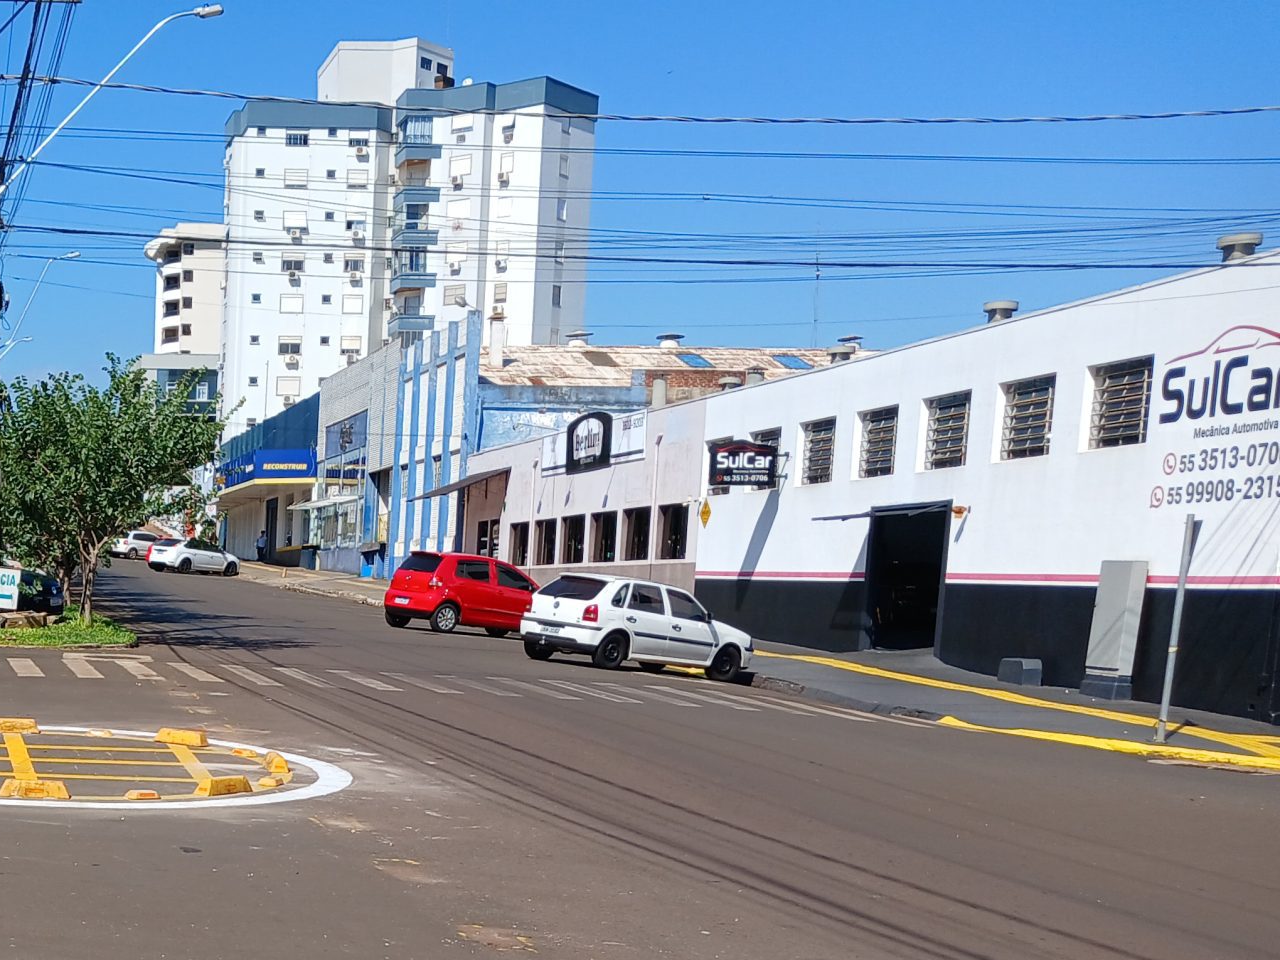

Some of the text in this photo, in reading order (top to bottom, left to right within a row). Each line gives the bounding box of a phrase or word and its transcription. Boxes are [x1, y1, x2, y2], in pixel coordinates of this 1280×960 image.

[1193, 418, 1279, 439] Mecânica Automotiva
[716, 452, 772, 469] SulCar
[1178, 441, 1280, 473] 55 3513-070
[1166, 486, 1183, 505] 55
